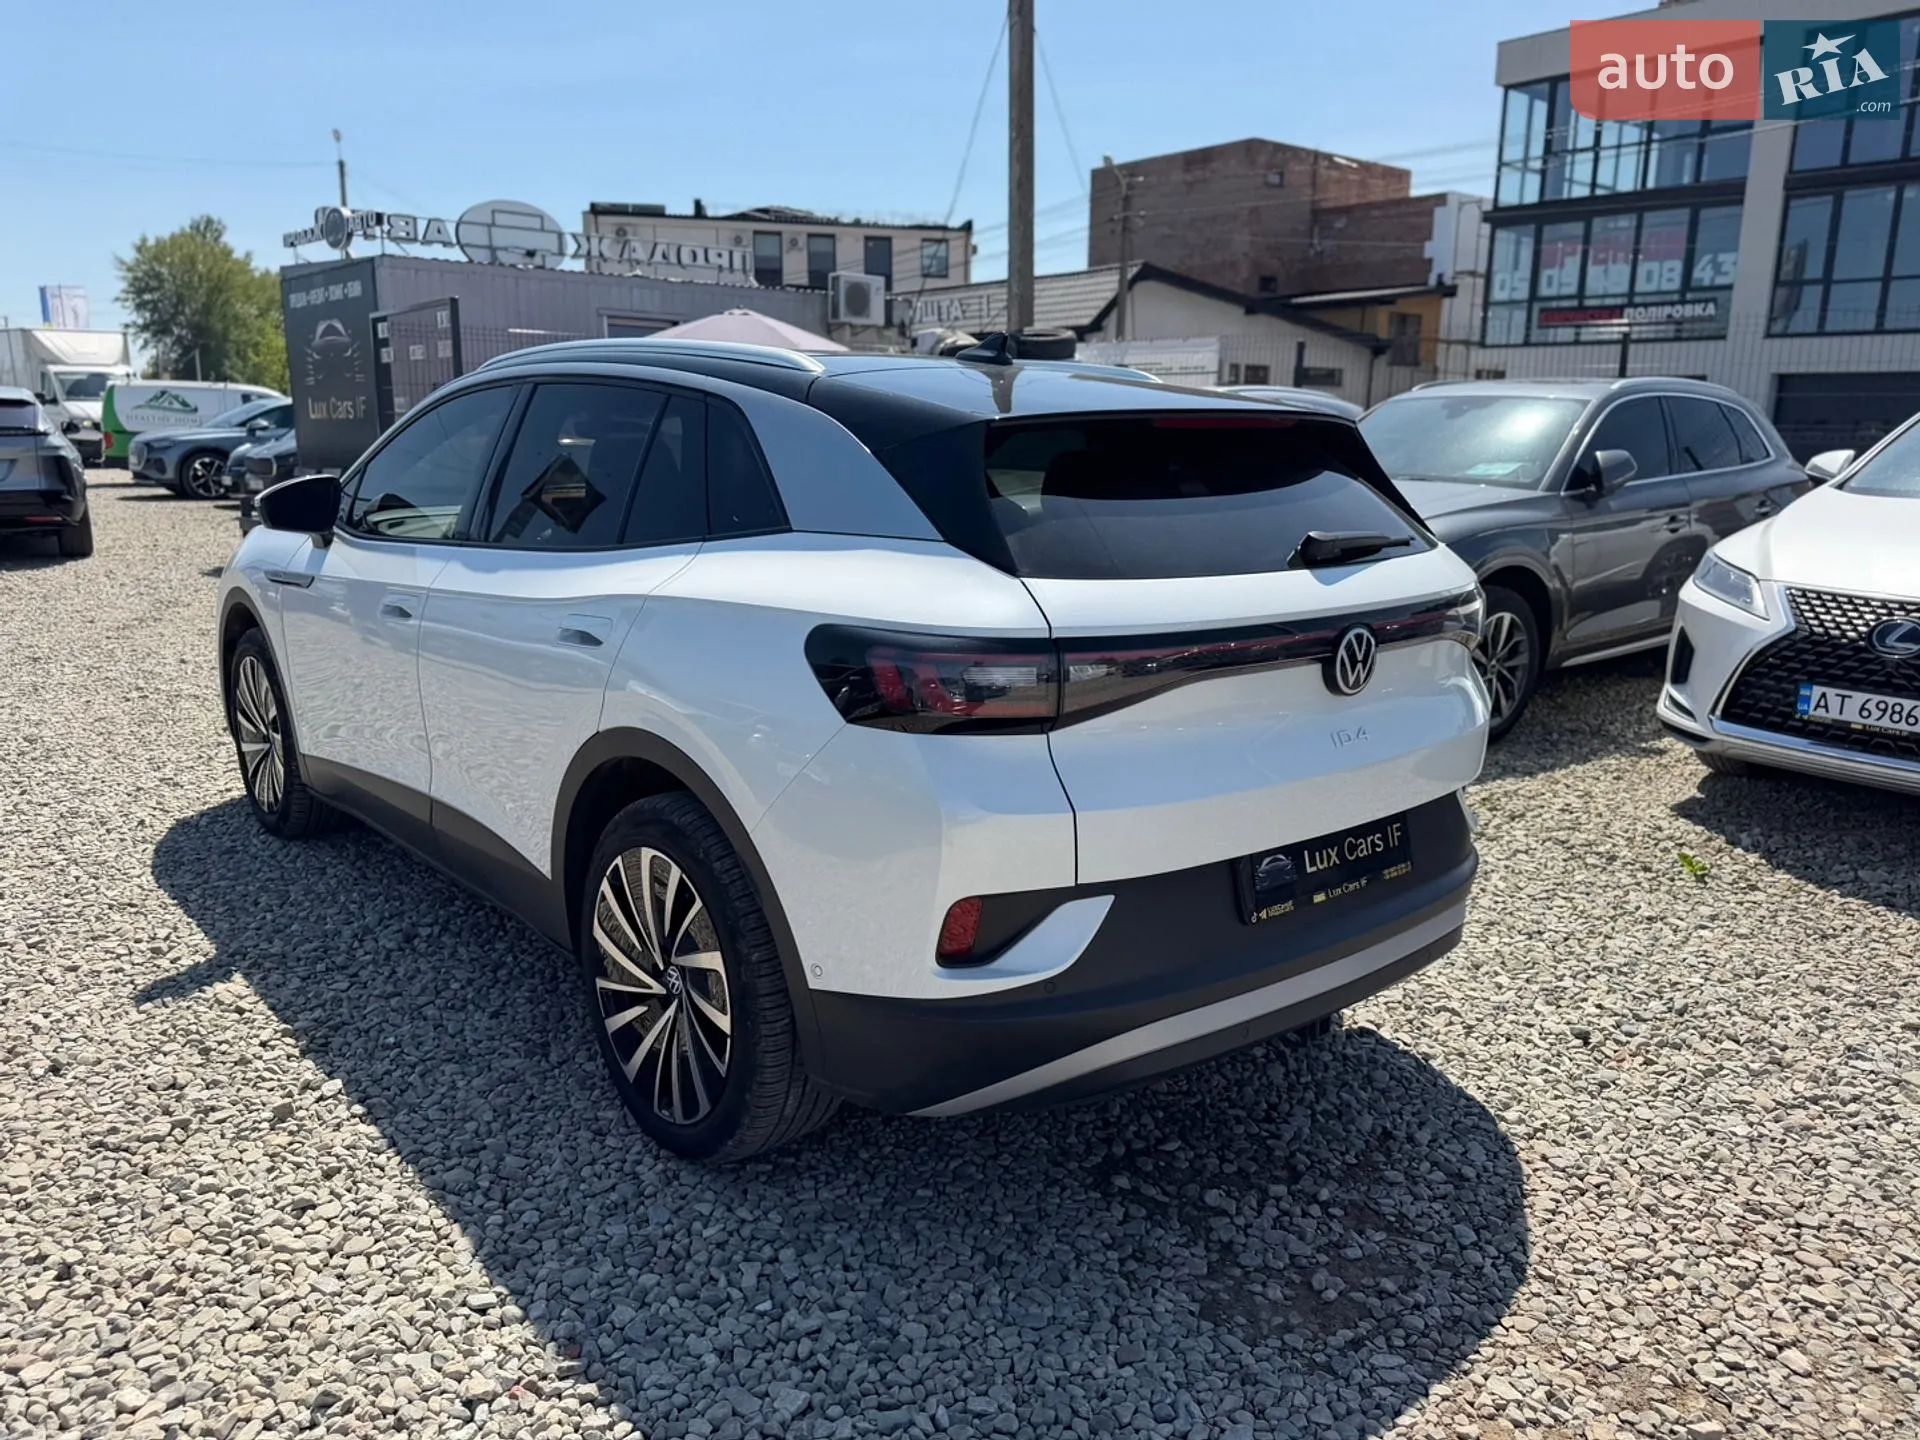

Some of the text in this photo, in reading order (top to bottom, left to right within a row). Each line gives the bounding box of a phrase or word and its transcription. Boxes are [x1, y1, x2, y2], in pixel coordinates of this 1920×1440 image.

[1624, 301, 1716, 321] ПОЛІРОВКА
[308, 397, 327, 420] Lux
[329, 397, 354, 419] Cars
[1814, 691, 1920, 727] AT 6986
[1303, 822, 1402, 874] Lux Cars IF
[1327, 887, 1343, 899] Lux
[1342, 880, 1360, 894] Cars
